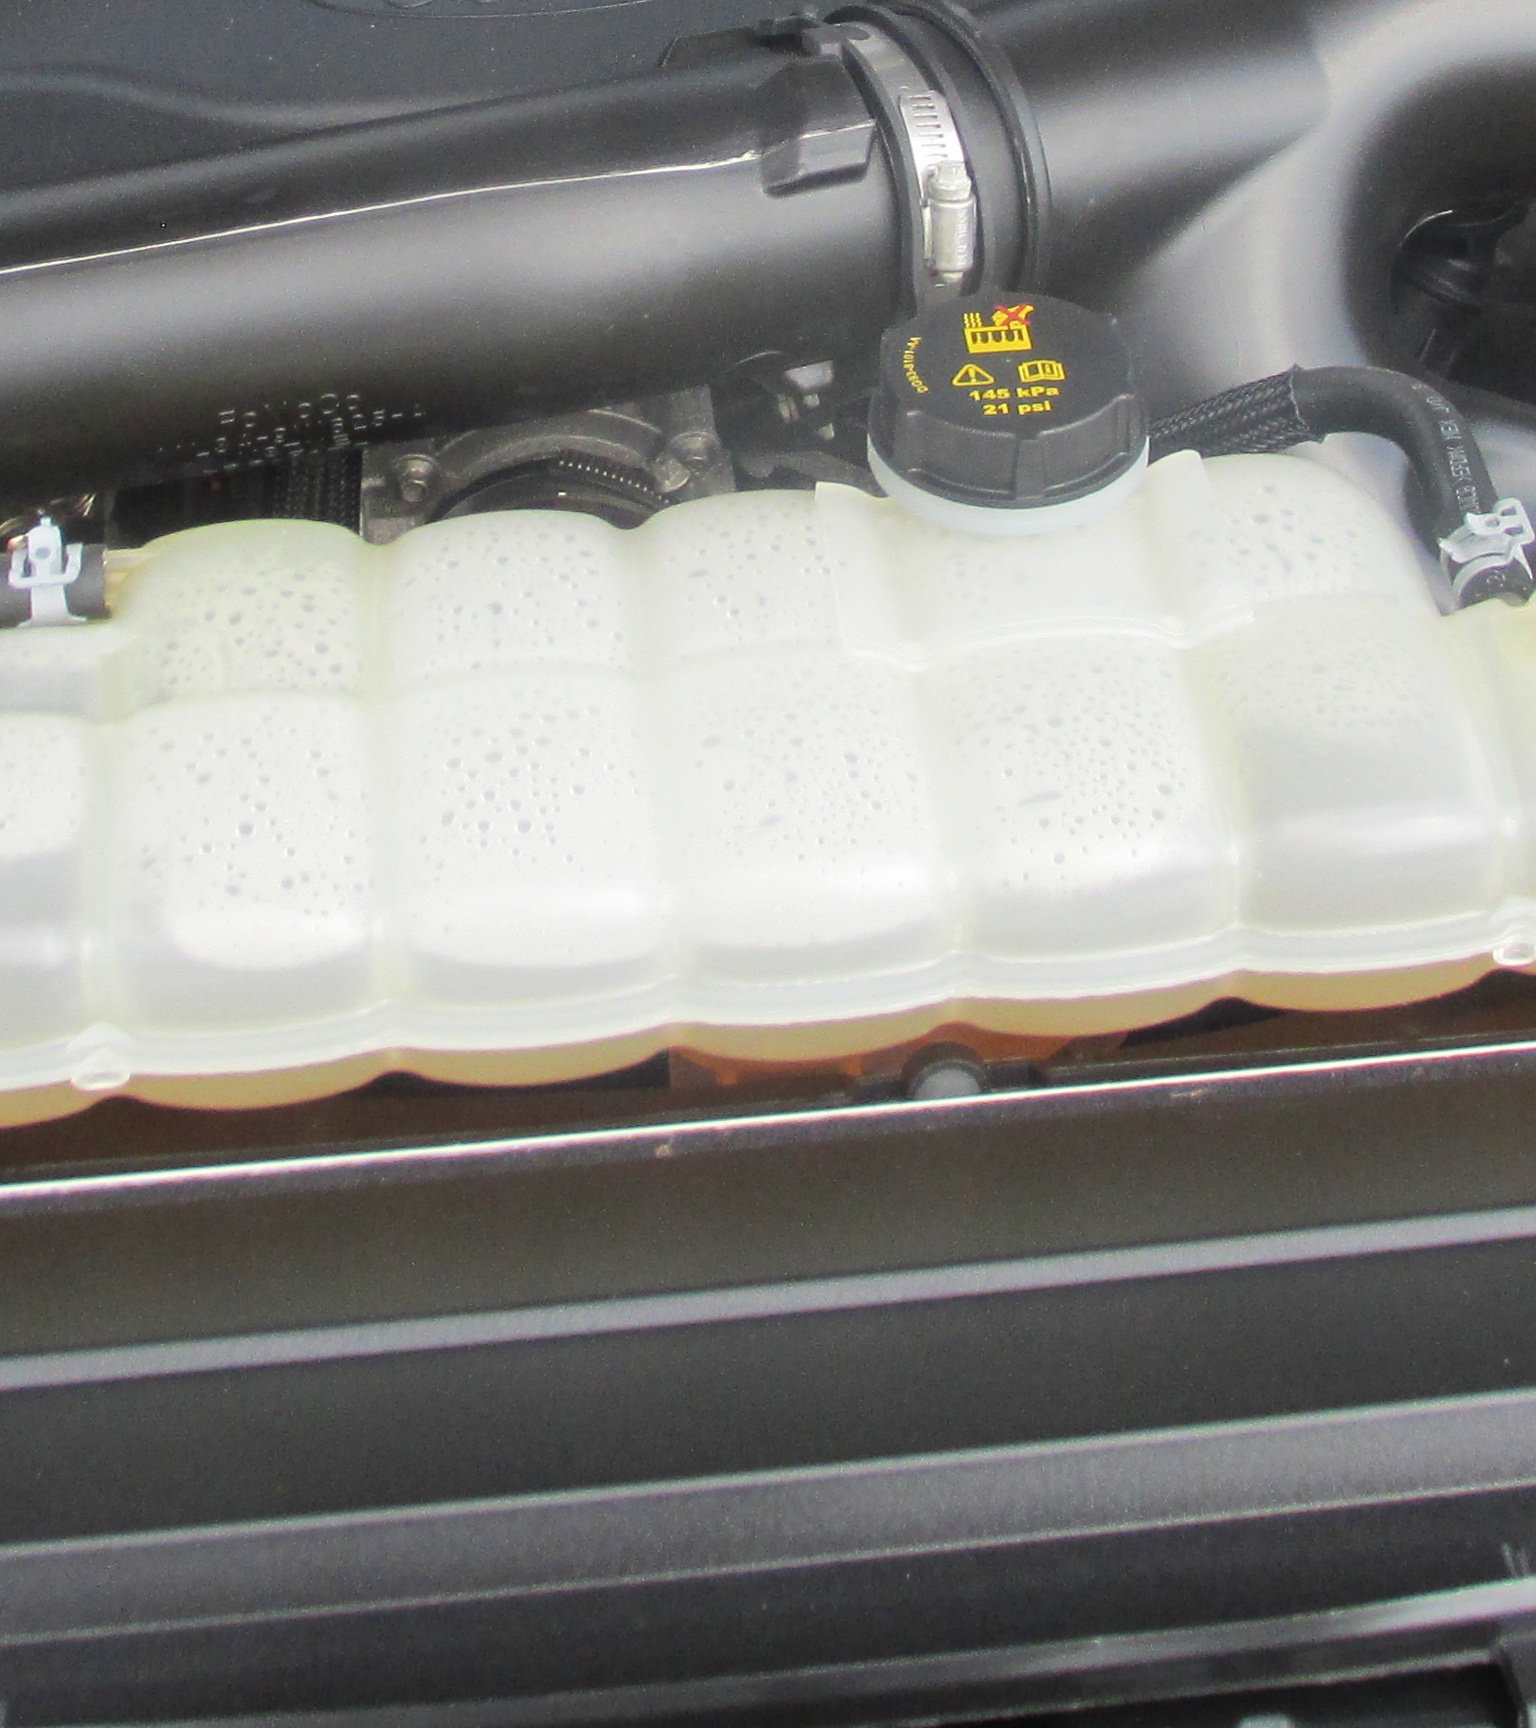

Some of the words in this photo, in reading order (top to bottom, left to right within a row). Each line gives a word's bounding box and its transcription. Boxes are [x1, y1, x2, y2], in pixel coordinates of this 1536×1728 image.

[969, 387, 1012, 401] 145
[1016, 385, 1062, 399] kPa
[982, 402, 1009, 416] 21
[1016, 399, 1052, 416] psi
